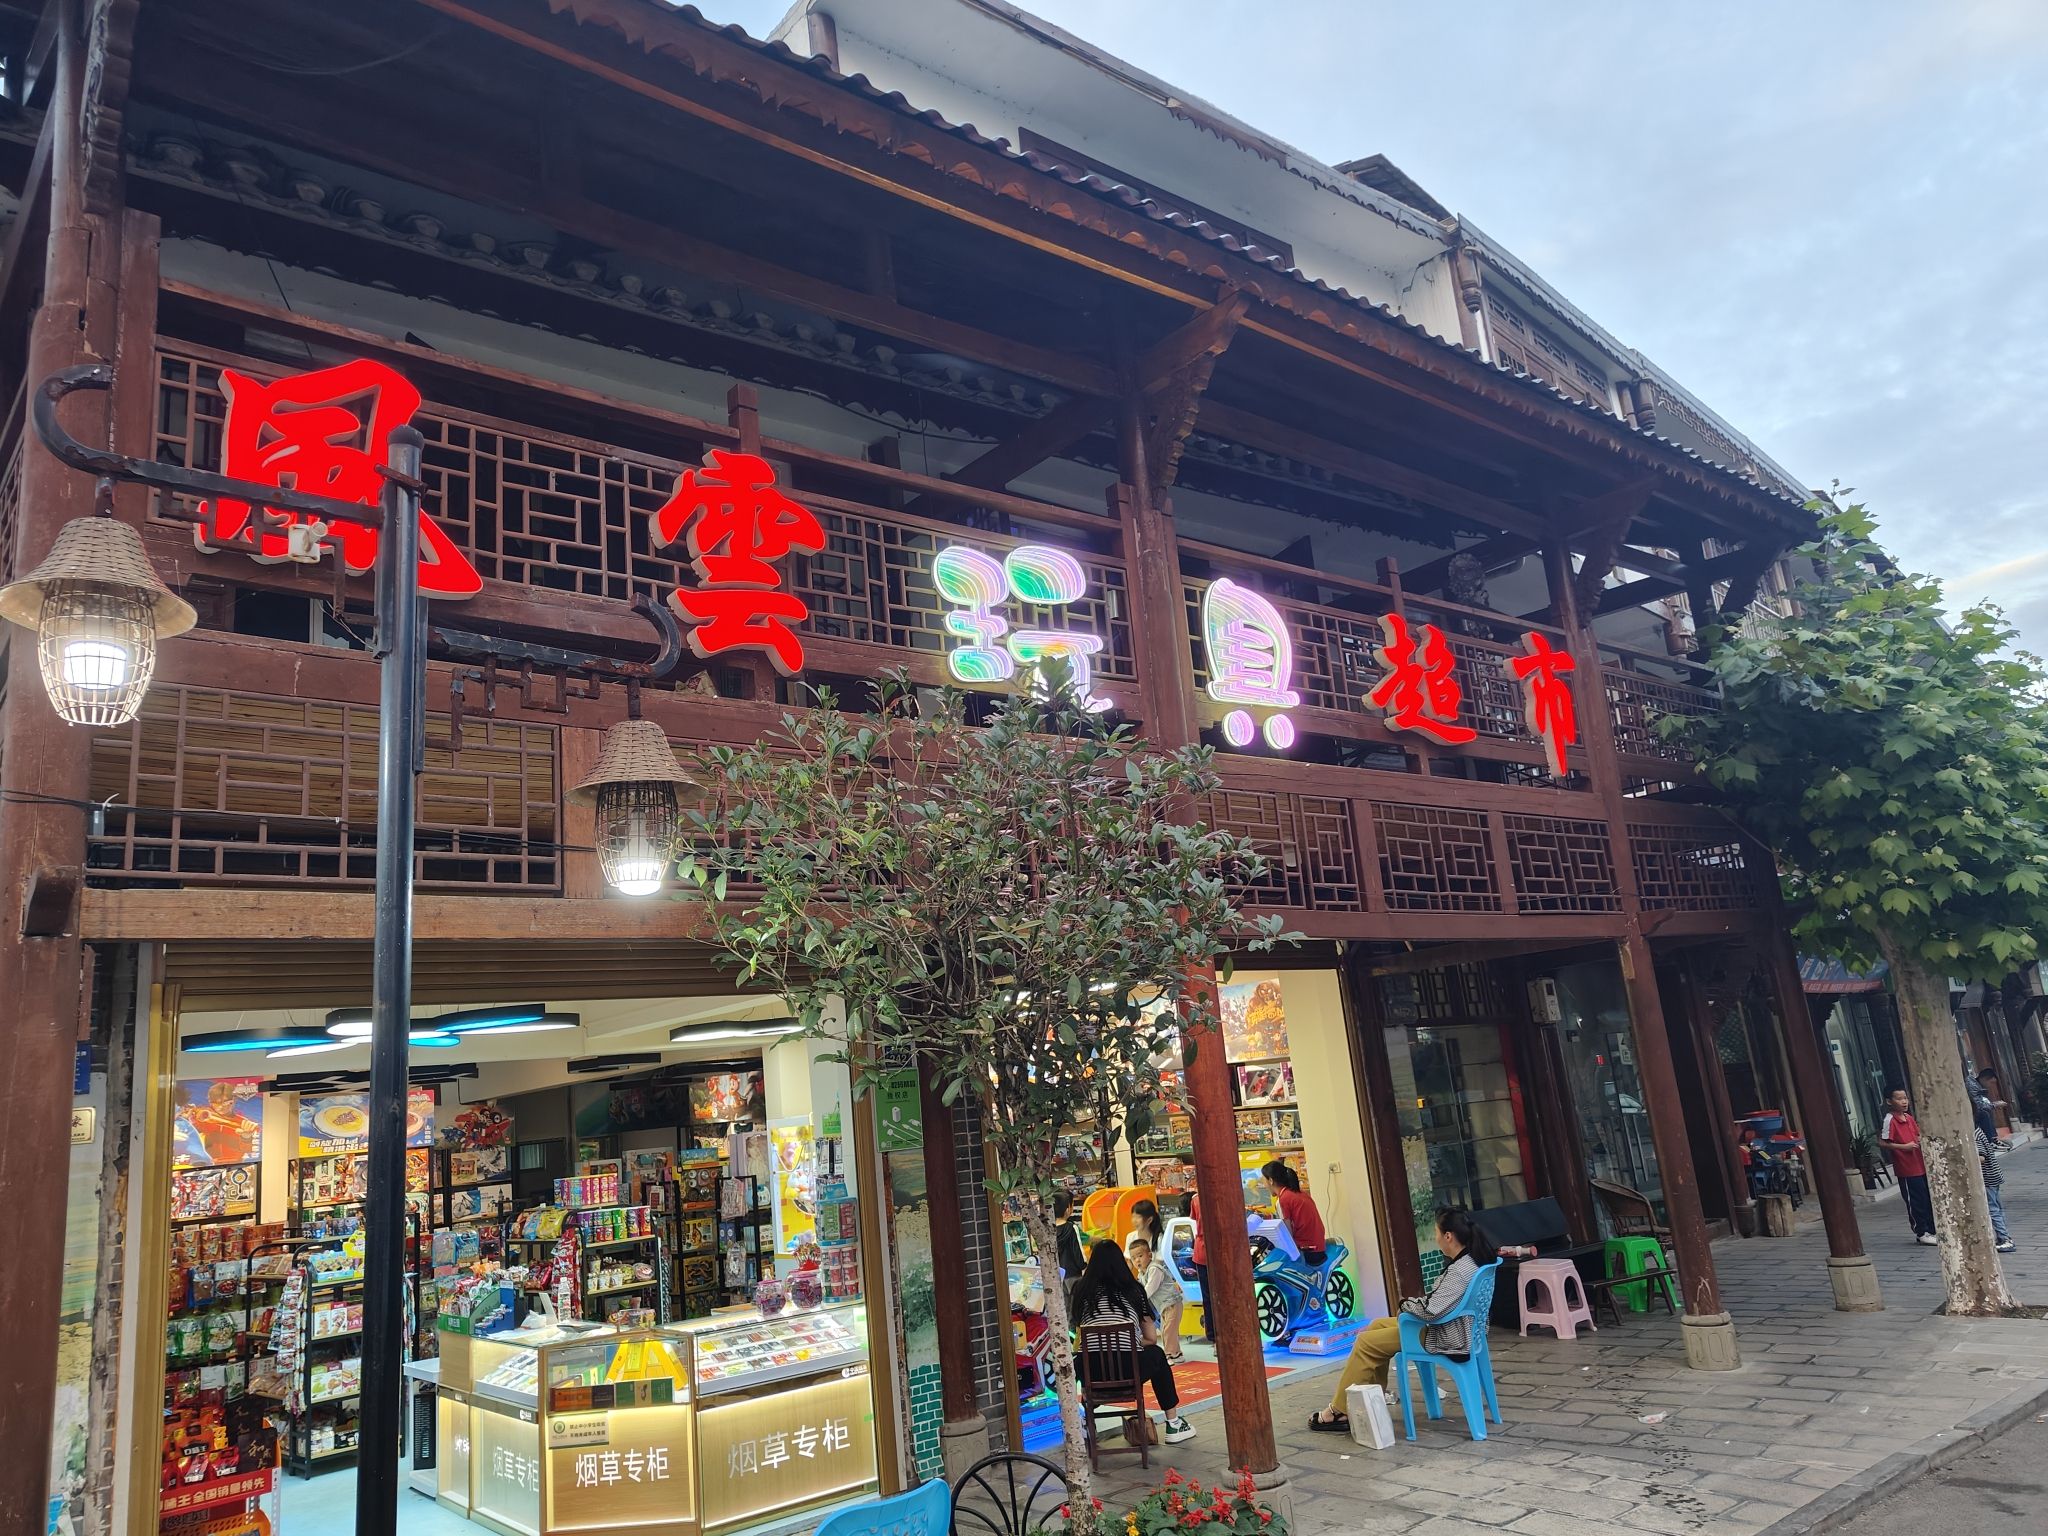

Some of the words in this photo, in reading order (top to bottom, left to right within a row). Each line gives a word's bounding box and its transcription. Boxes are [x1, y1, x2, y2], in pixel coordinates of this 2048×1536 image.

[575, 1446, 670, 1488] 烟草专柜
[727, 1417, 851, 1479] 烟草专柜
[160, 1477, 265, 1511] 味王全国销量领先
